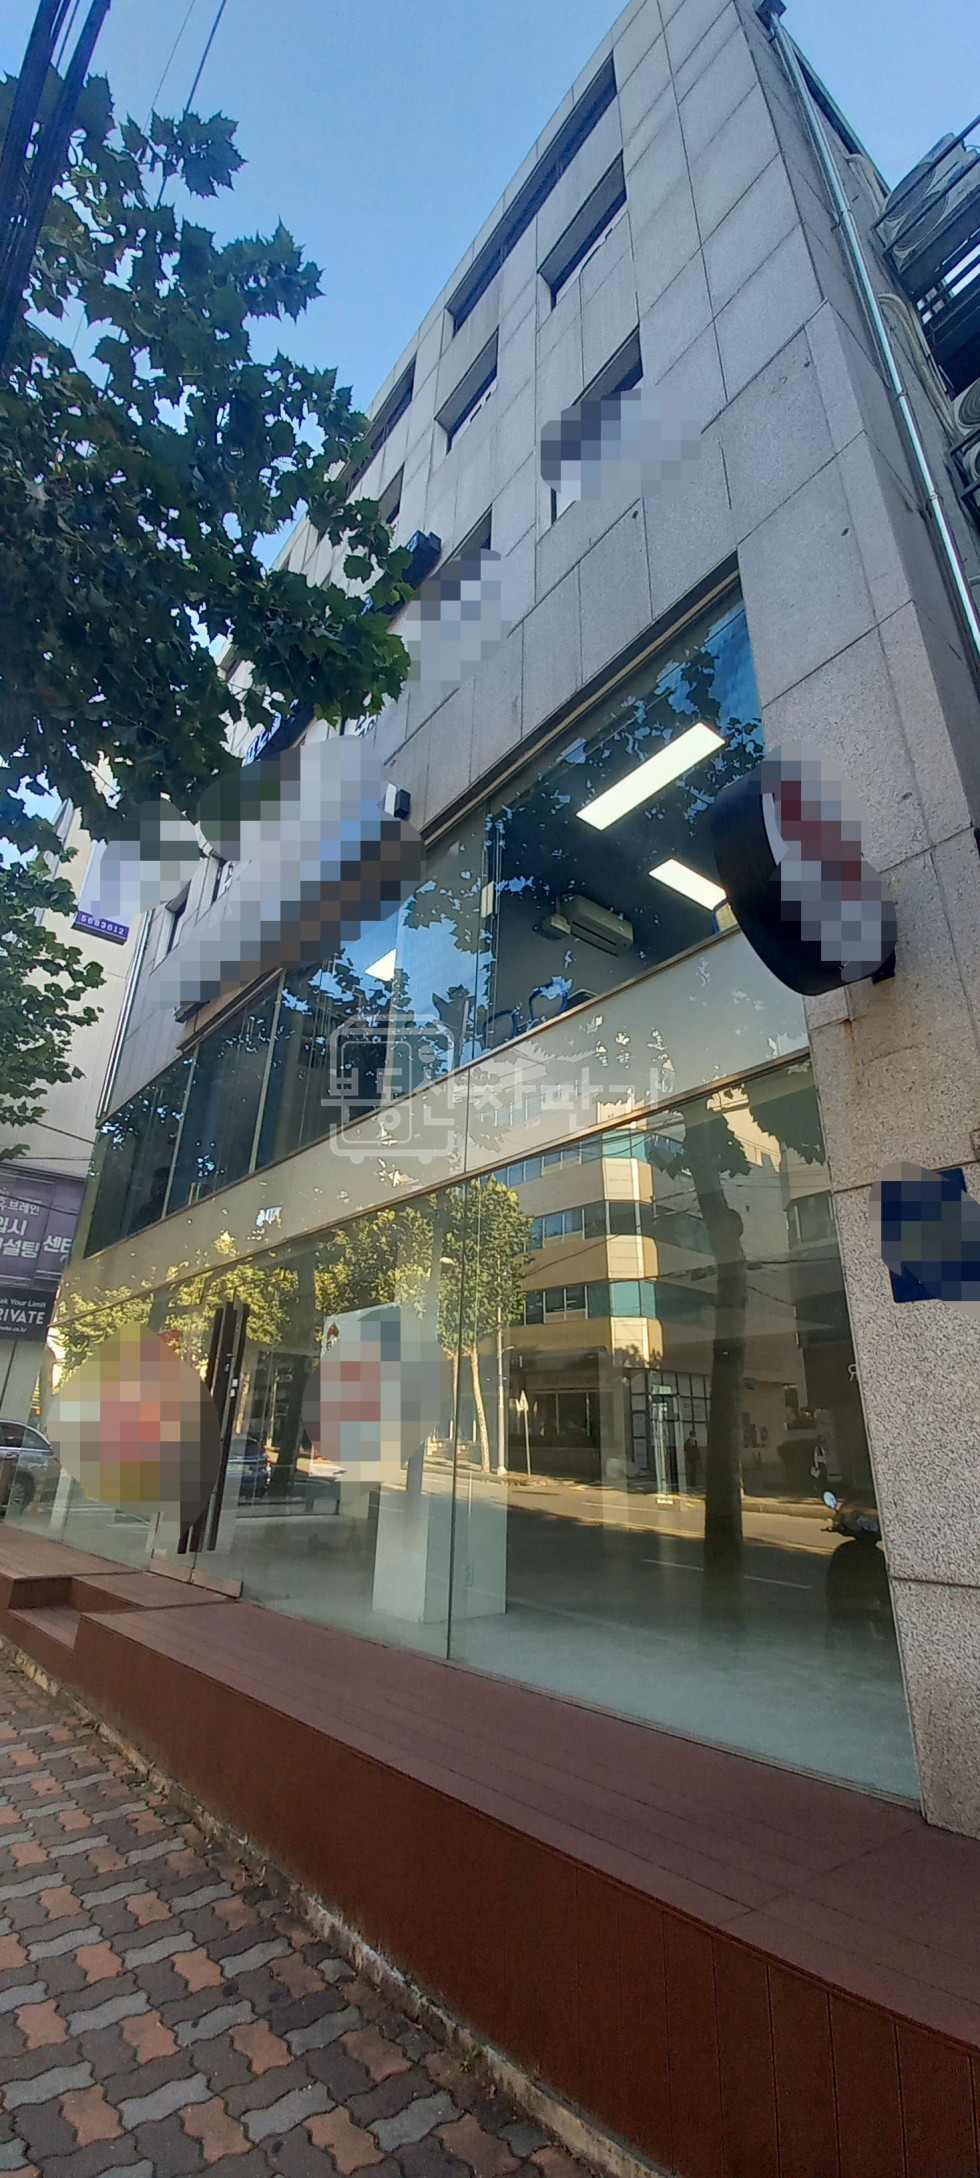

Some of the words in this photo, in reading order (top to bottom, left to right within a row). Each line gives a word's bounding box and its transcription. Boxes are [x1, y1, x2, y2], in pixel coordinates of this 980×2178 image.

[0, 1215, 28, 1236] 입시
[0, 1237, 40, 1259] 설팅
[27, 1300, 47, 1308] Limit
